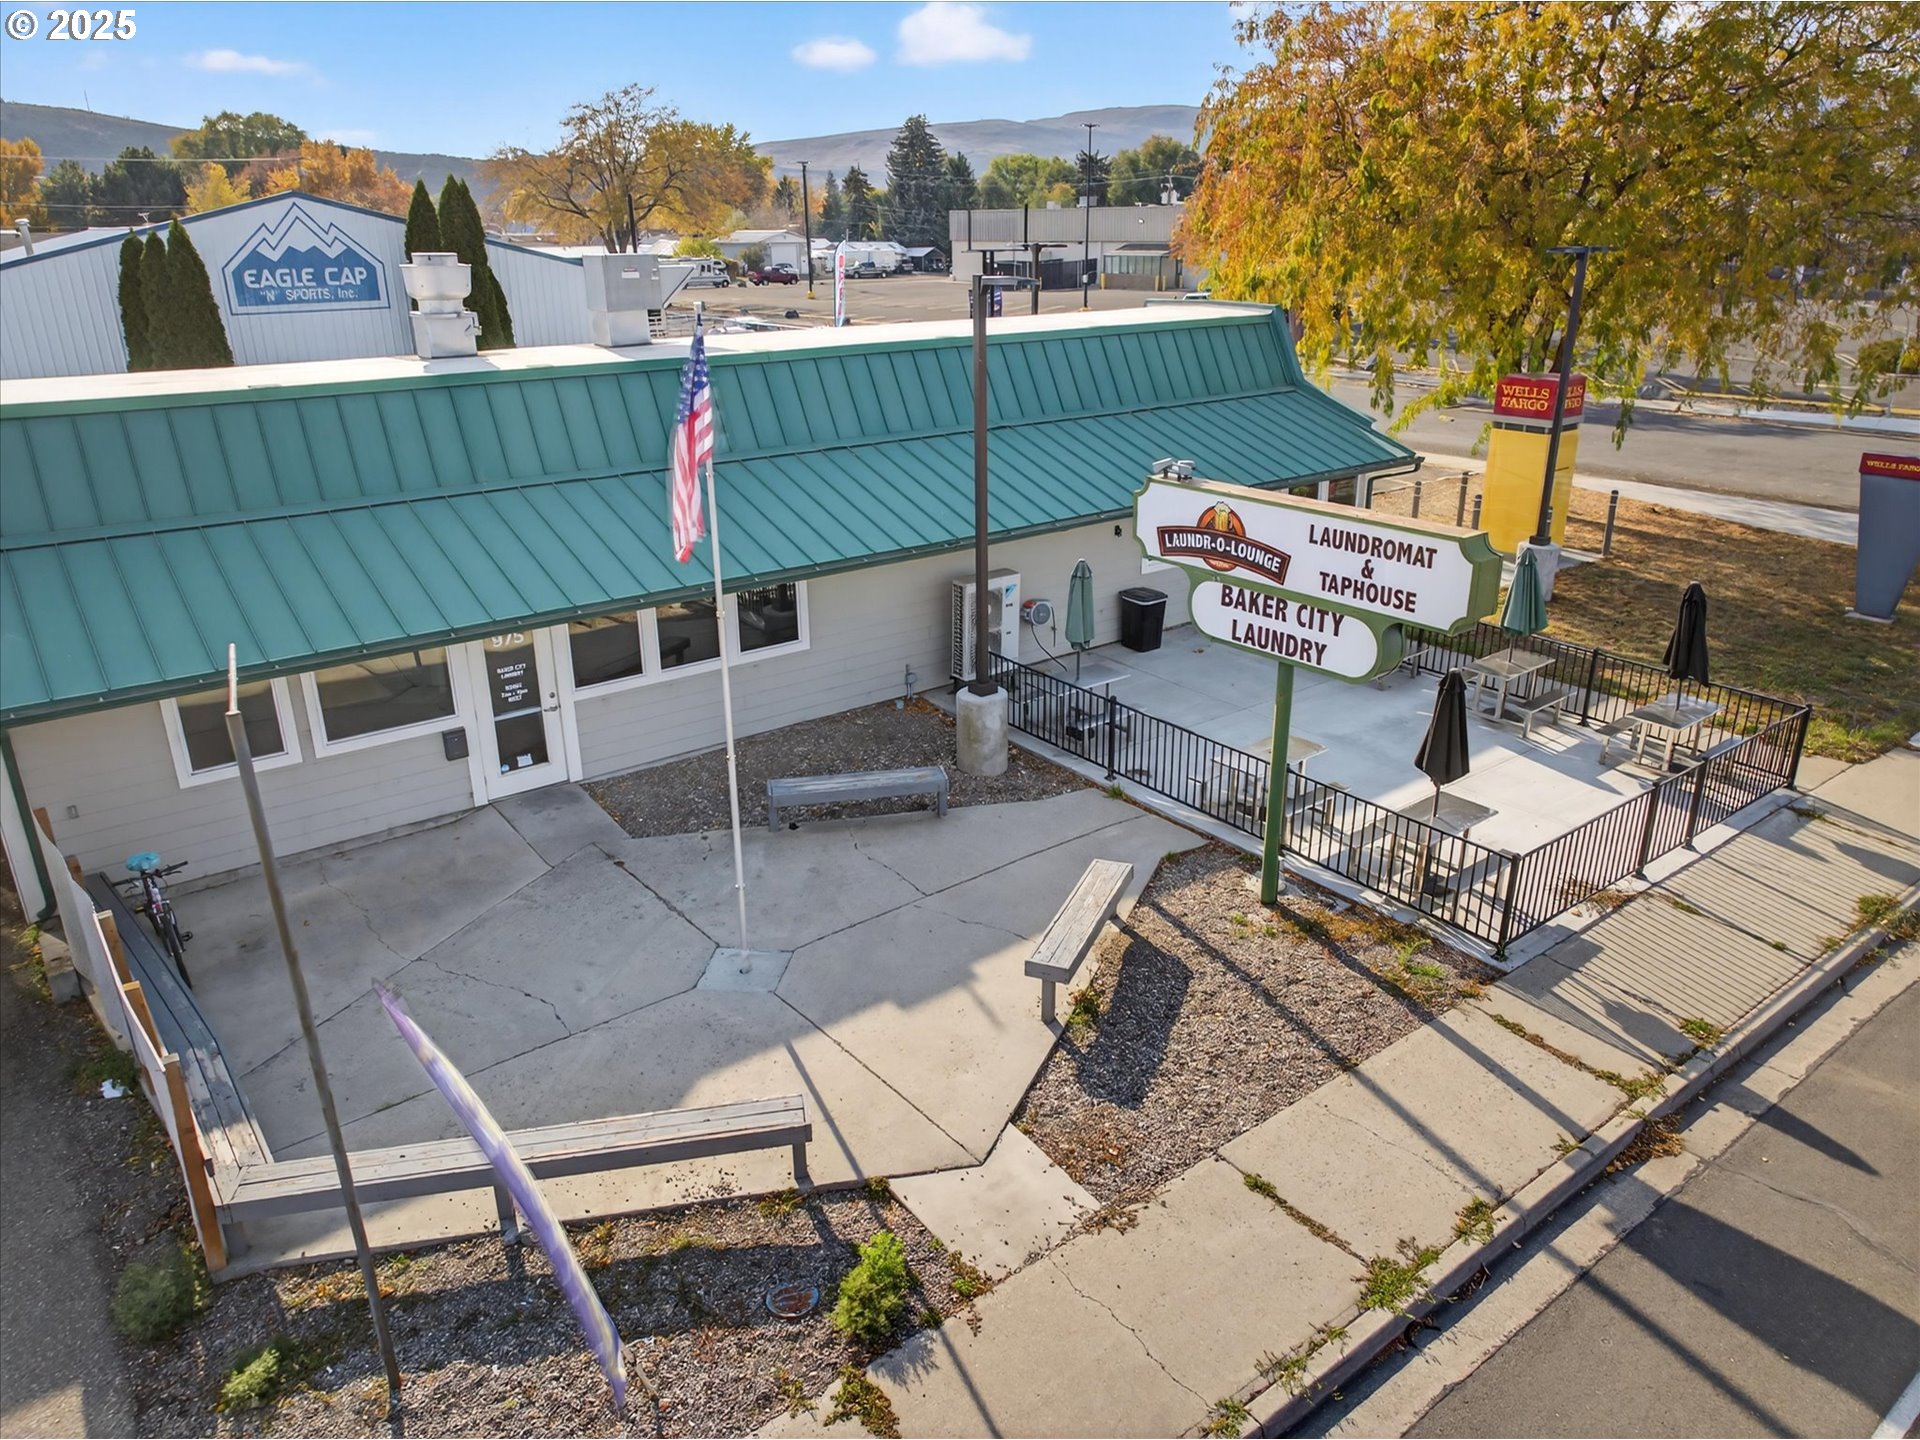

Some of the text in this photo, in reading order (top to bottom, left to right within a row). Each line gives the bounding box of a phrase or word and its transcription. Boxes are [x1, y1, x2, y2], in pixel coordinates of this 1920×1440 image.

[243, 266, 368, 289] EAGLE CAP
[1501, 384, 1550, 399] WELLS
[1501, 397, 1548, 411] FARGO
[1164, 532, 1282, 574] LAUNDR-O-LOUNGE
[1308, 524, 1438, 569] LAUNDROMAT
[1361, 558, 1374, 580] &
[1220, 583, 1345, 637] BAKER CITY
[1319, 571, 1417, 613] TAPHOUSE
[1231, 618, 1328, 666] LAUNDRY
